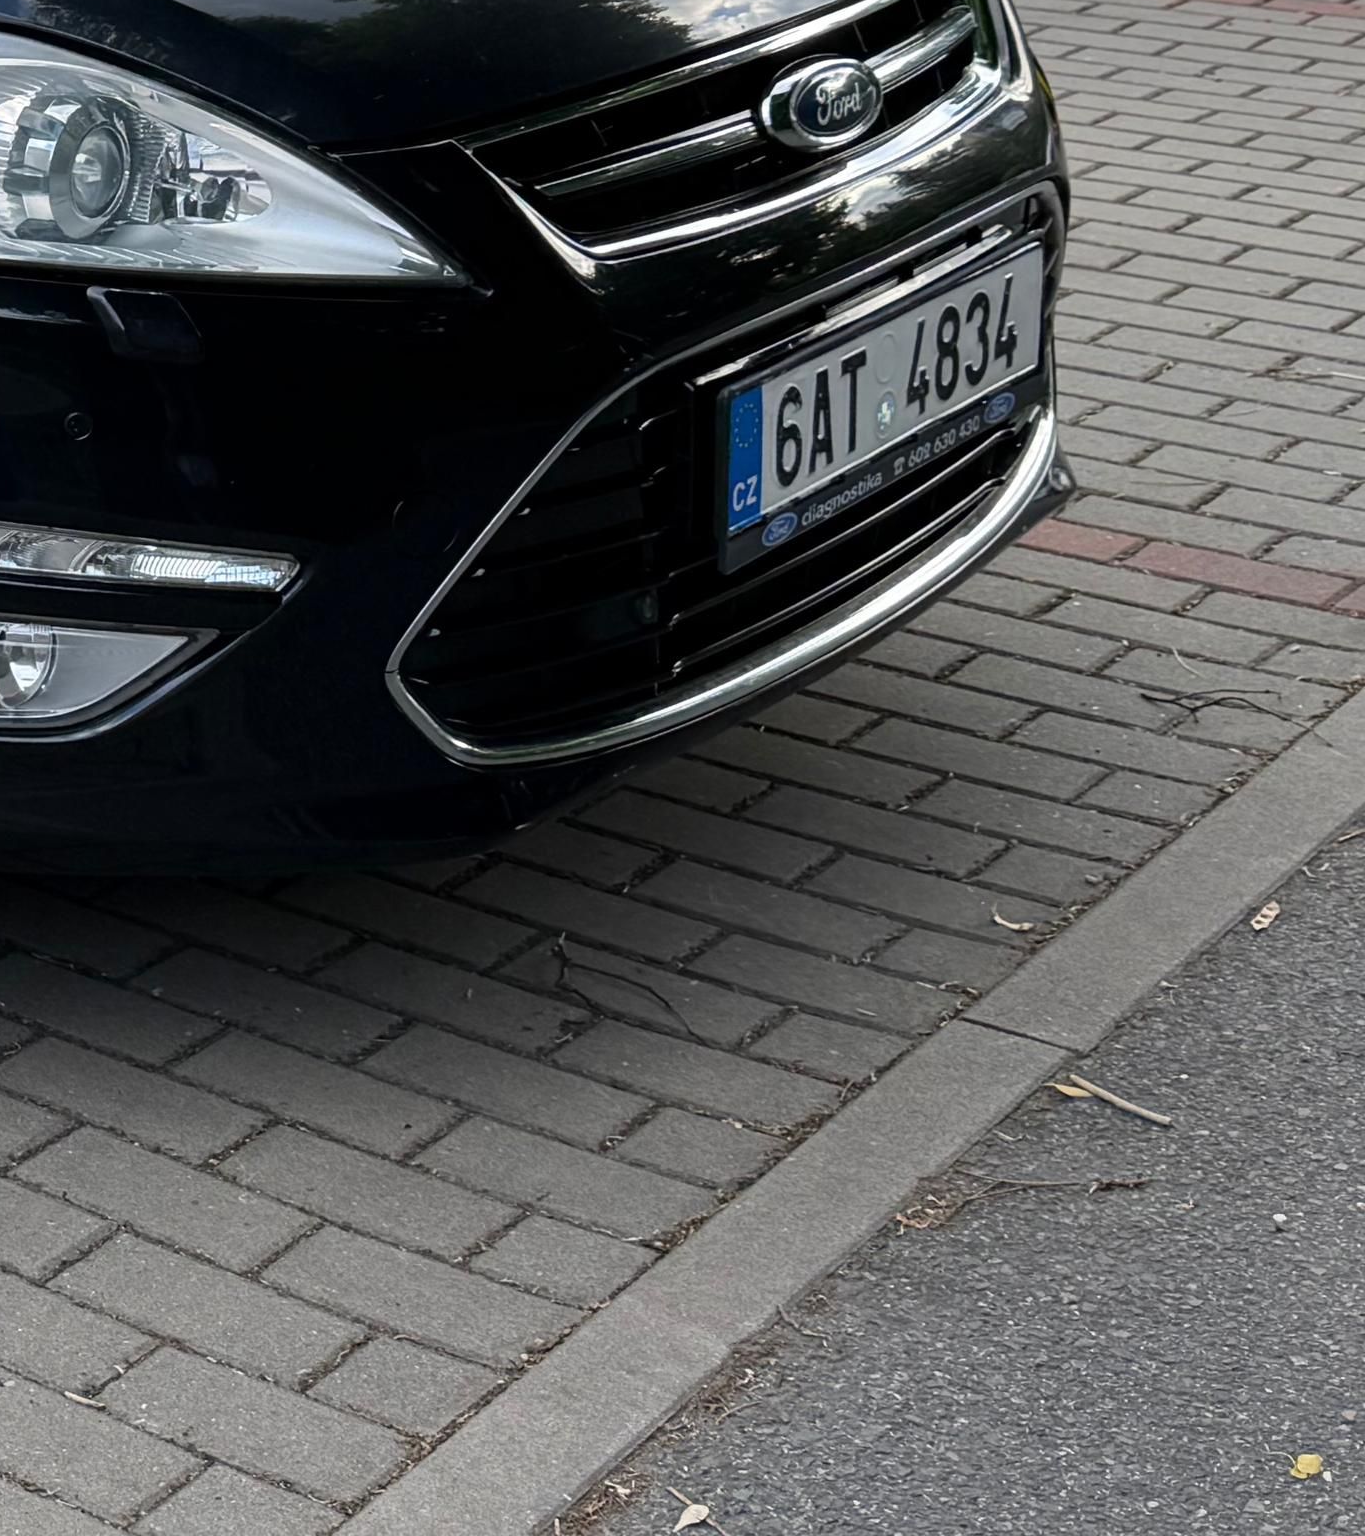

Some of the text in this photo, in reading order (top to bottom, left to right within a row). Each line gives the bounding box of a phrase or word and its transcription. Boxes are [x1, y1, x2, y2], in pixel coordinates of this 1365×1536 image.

[814, 78, 864, 128] Ford
[774, 272, 1018, 488] 6AT 4834
[732, 473, 758, 513] CZ
[801, 471, 884, 526] diagnostika
[933, 428, 957, 454] 630
[958, 415, 981, 440] 430
